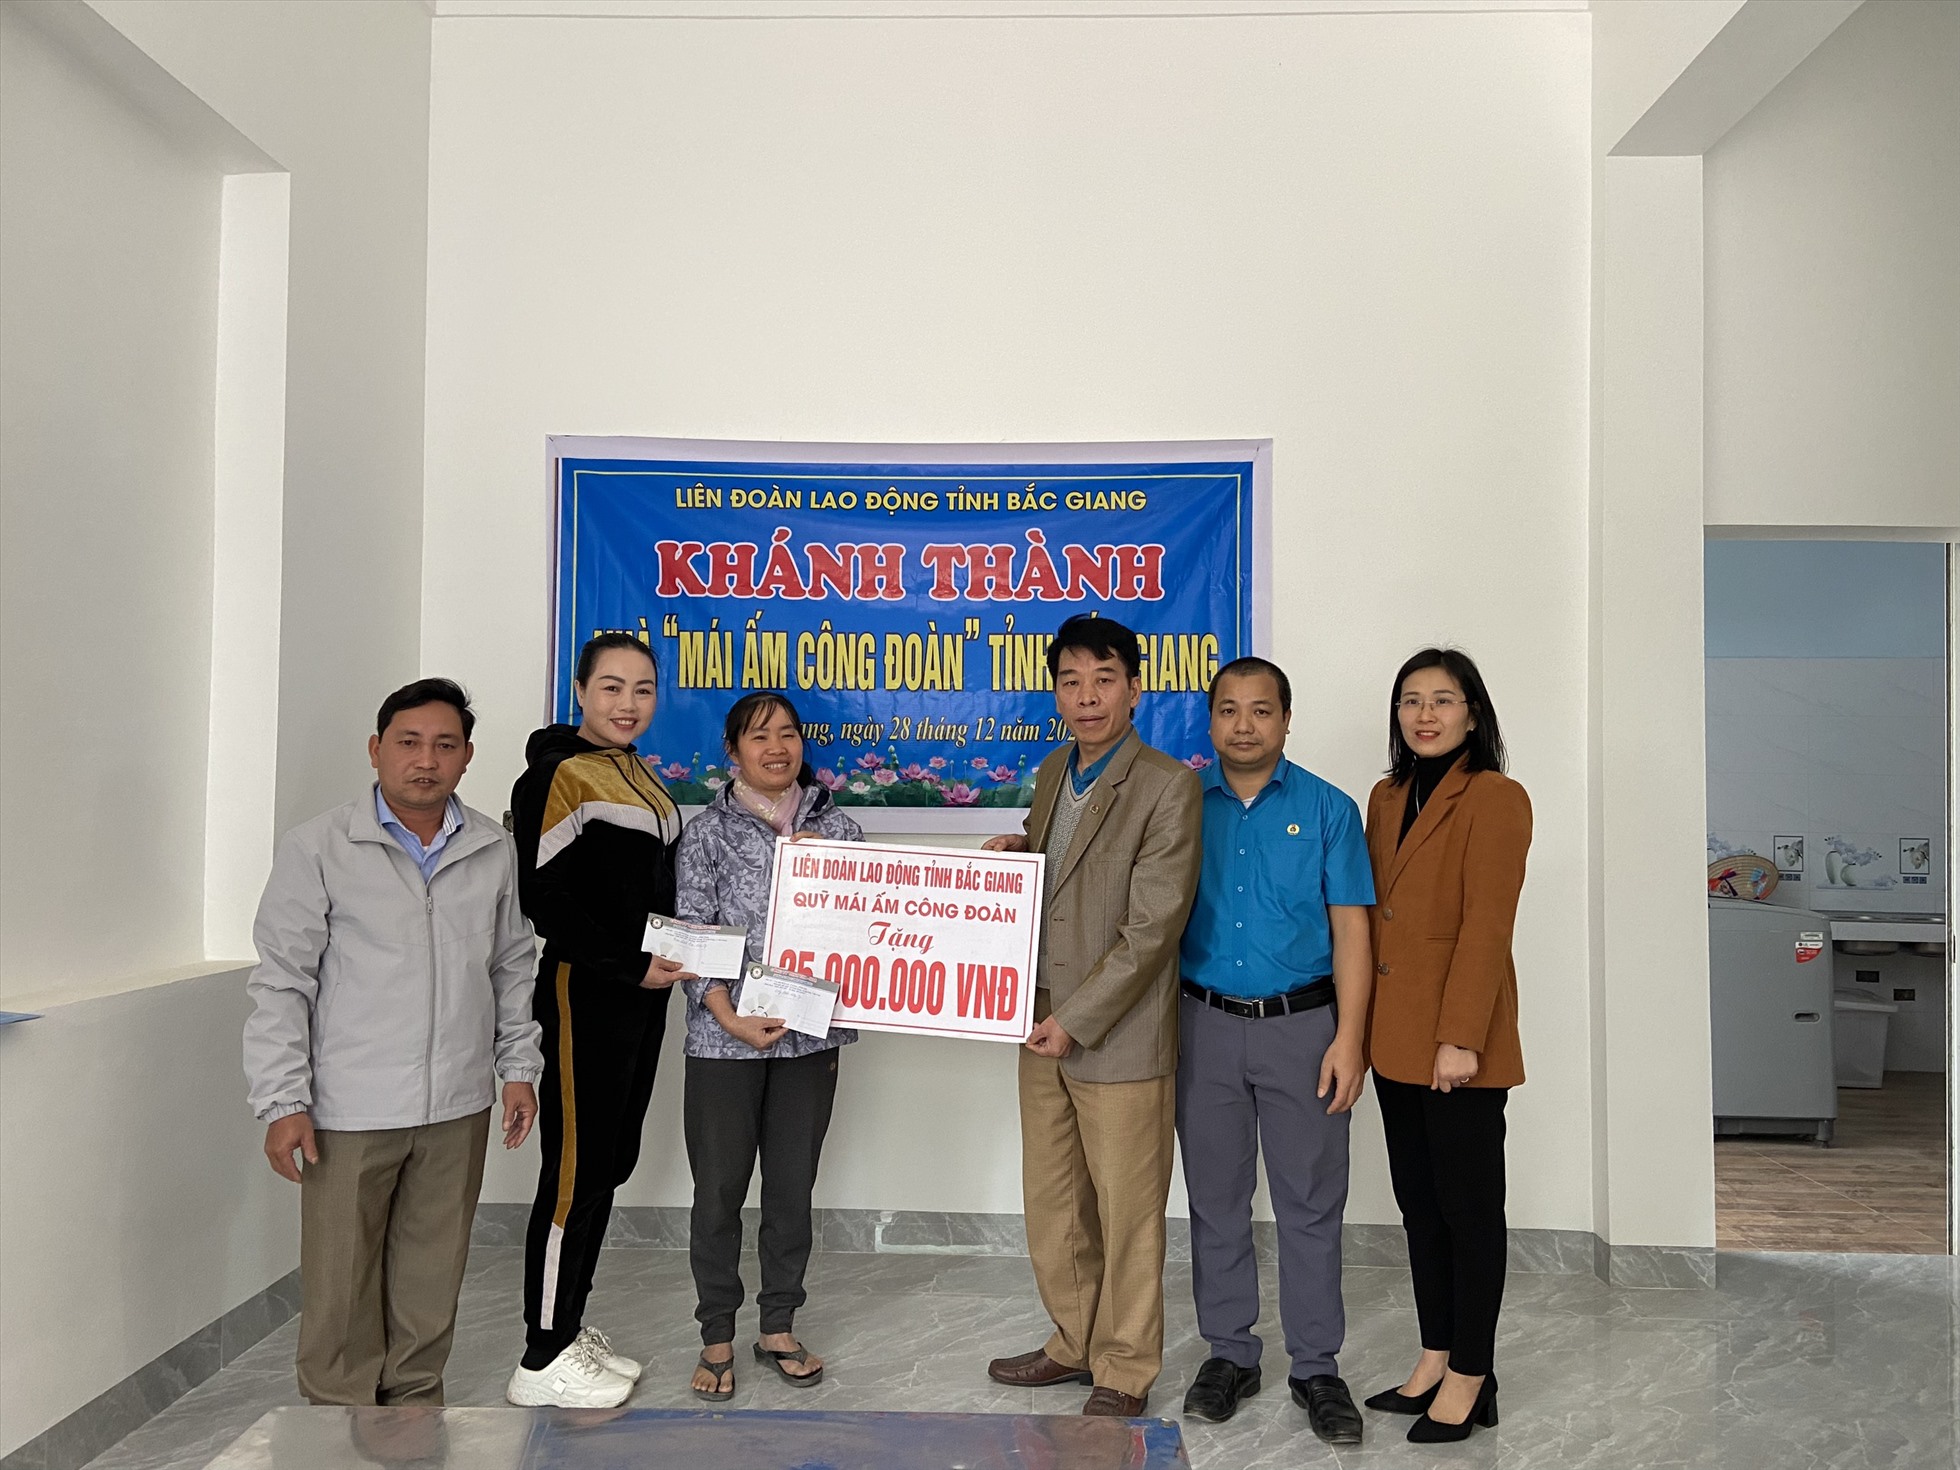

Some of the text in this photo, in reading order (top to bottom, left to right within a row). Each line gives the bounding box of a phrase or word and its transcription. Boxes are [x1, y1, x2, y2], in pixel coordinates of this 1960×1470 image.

[675, 482, 1147, 516] LIÊN ĐOÀN LAO ĐỘNG TỈNH BẮC GIANG
[654, 526, 1165, 602] KHÁNH THÀNH
[662, 614, 733, 689] “MÁI
[741, 610, 789, 690] ẤM
[796, 619, 877, 691] CÔNG
[884, 618, 981, 692] ĐOÀN”
[988, 612, 1055, 692] TỈNH
[840, 715, 884, 747] ngày
[889, 716, 911, 741] 28
[916, 716, 968, 748] tháng
[974, 717, 996, 742] 12
[1000, 717, 1040, 742] năm
[792, 855, 1023, 894] LIÊN ĐOÀN LAO ĐỘNG TỈNH BẮC GIANG
[793, 891, 1017, 923] QUỸ MÁI ẤM CÔNG ĐOÀN
[868, 921, 934, 954] Tặng
[956, 963, 1019, 1021] VNĐ
